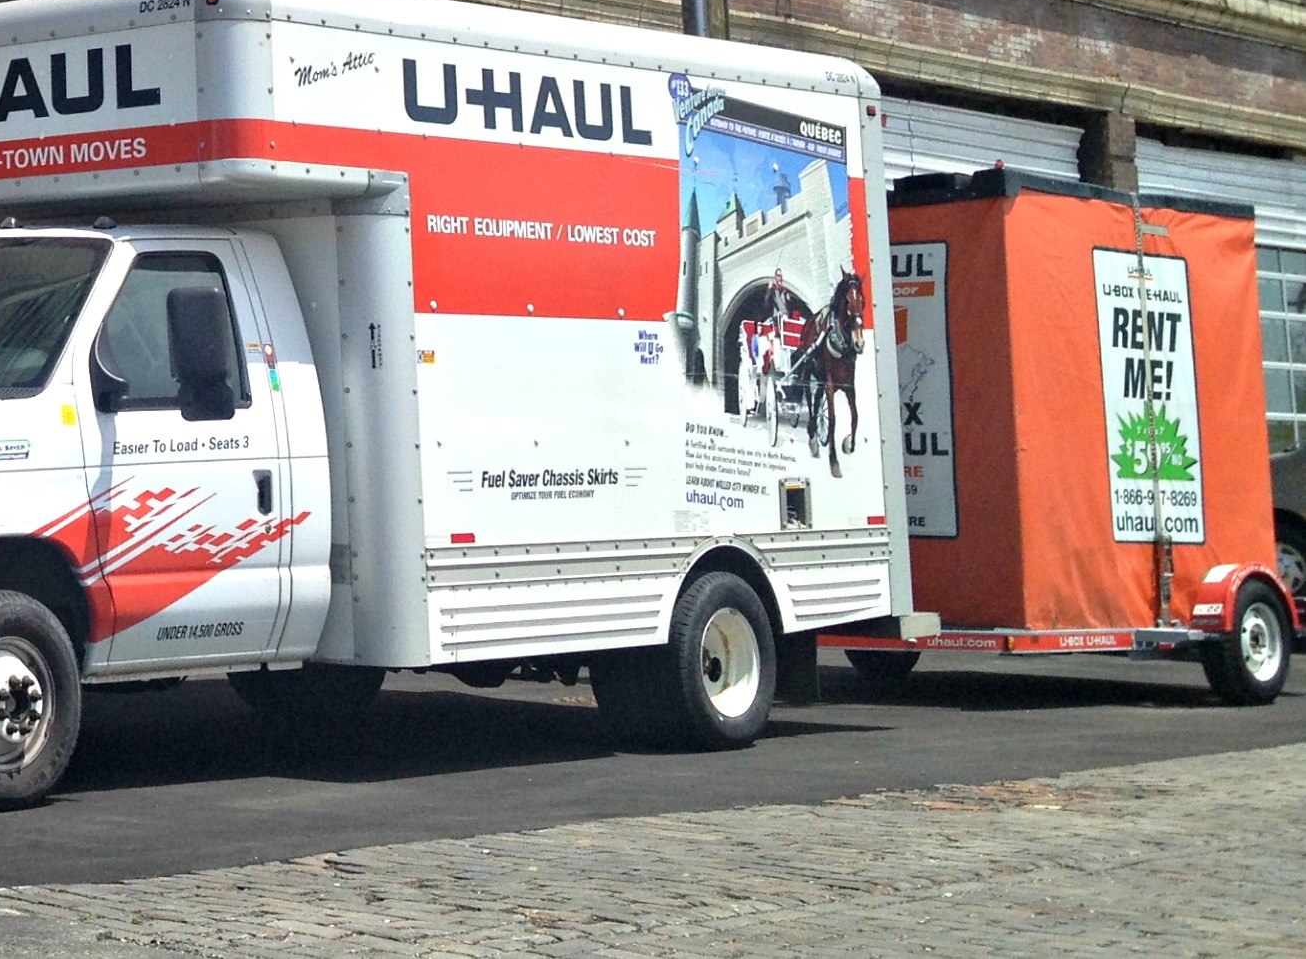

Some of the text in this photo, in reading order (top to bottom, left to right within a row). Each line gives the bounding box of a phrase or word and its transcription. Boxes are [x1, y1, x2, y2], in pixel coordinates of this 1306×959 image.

[140, 0, 154, 13] DC
[402, 58, 653, 146] U-HAUL
[685, 95, 725, 155] Canada
[799, 121, 842, 145] QUÉBEC
[70, 138, 147, 163] MOVES
[427, 214, 469, 234] RIGHT
[474, 217, 553, 240] EQUIPMENT
[567, 225, 619, 245] LOWEST
[623, 228, 656, 247] COST
[1112, 307, 1182, 353] RENT
[1123, 357, 1174, 402] ME!
[113, 435, 250, 455] Easier To Load Seats 3
[481, 470, 506, 489] Fuel
[542, 468, 585, 488] Chassis
[587, 467, 619, 486] Skirts
[510, 489, 595, 501] OPTIMIZE YOUR FUEL ECONOMY
[685, 489, 745, 512] uhaul.com
[1114, 488, 1197, 507] 1-866-97-8269
[157, 621, 245, 641] UNDER 14,500 GROSS
[926, 634, 996, 648] uhaul.com
